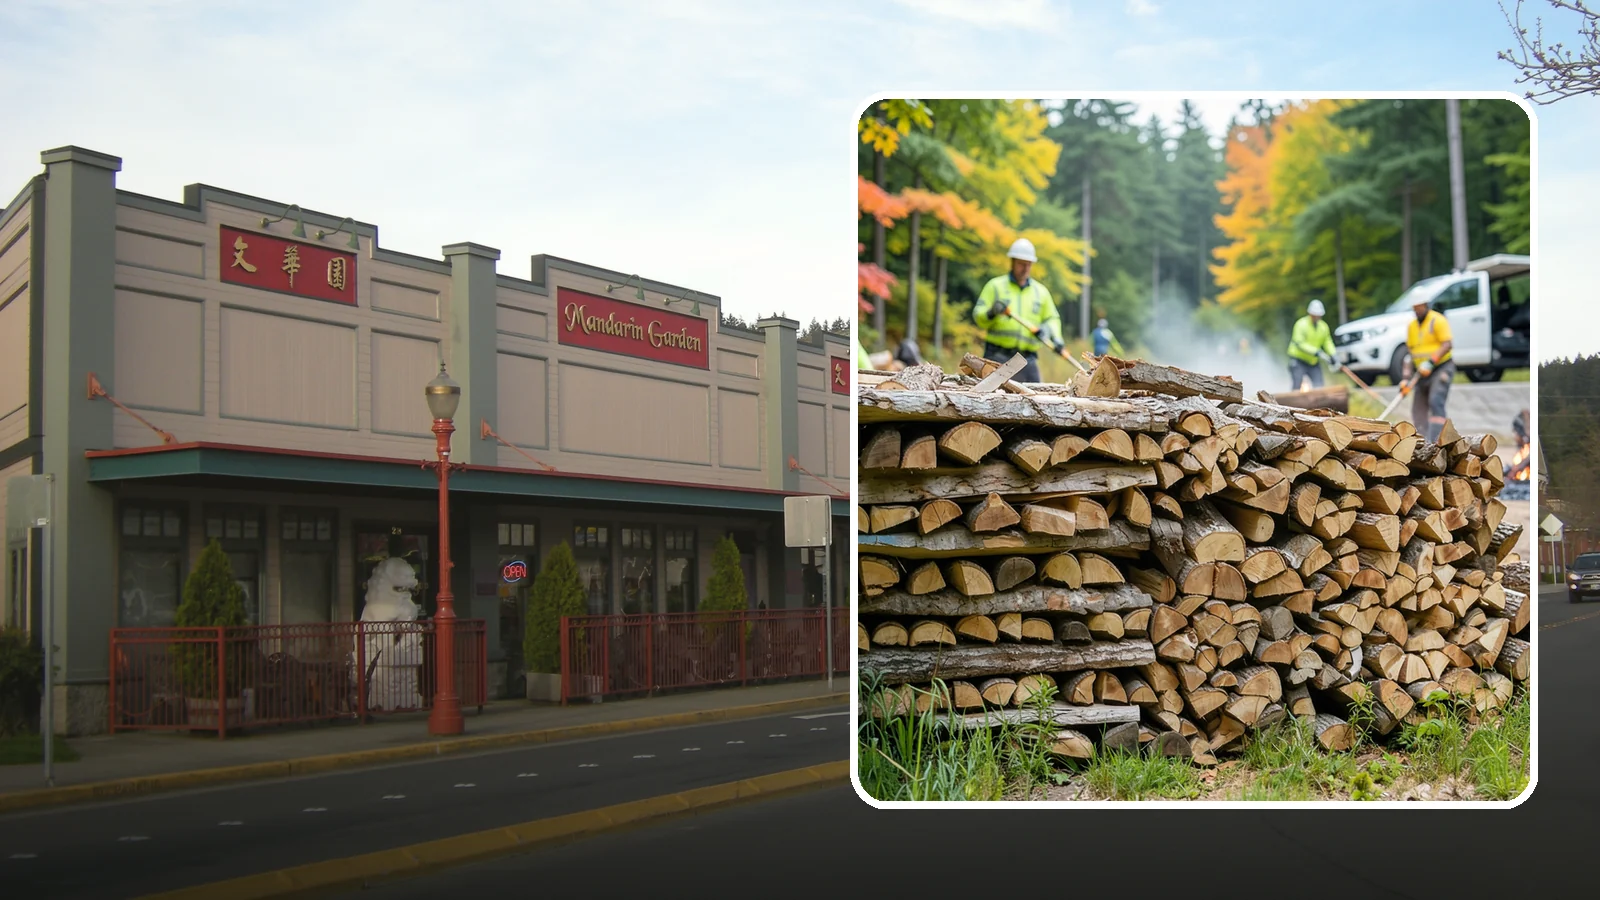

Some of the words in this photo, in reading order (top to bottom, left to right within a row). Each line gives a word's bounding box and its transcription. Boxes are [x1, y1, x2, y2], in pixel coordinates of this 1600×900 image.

[230, 235, 346, 291] 文華園
[564, 302, 644, 341] Mandarin
[648, 320, 702, 352] Garden
[503, 565, 527, 578] OPEN
